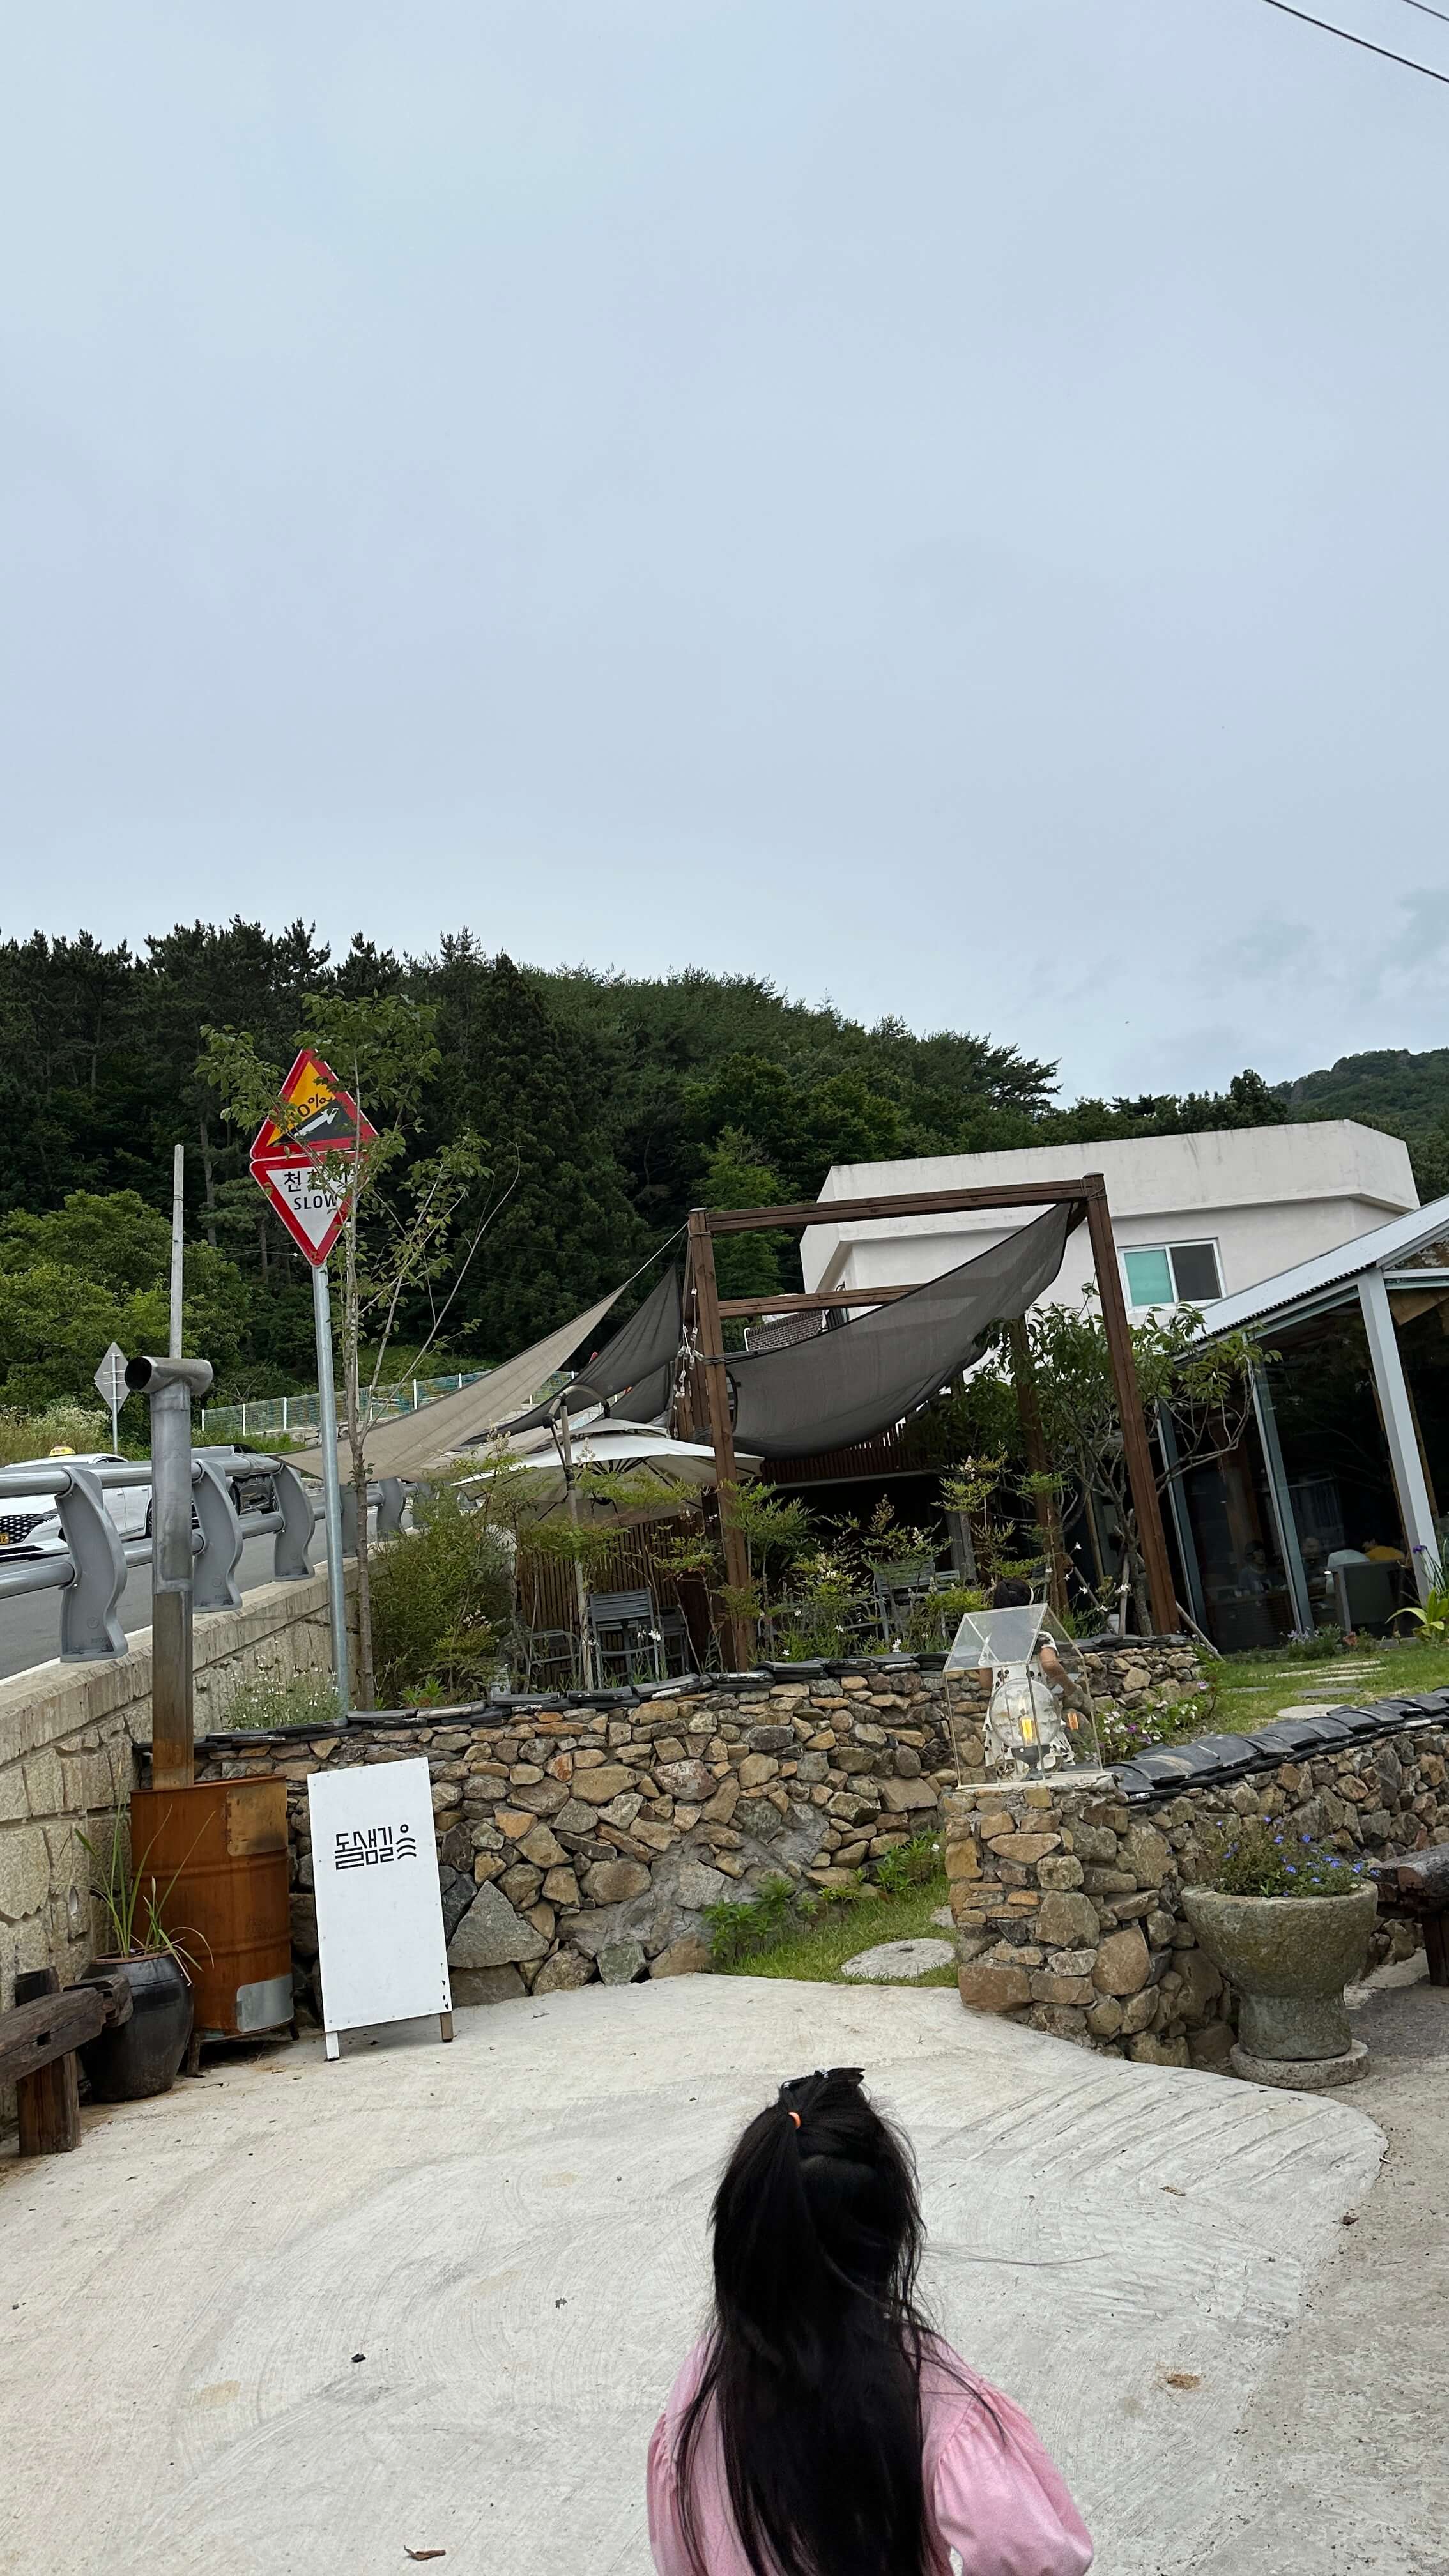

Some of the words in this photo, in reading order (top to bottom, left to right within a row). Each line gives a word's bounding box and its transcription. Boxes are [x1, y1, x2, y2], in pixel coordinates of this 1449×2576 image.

[288, 1093, 326, 1123] 0%
[294, 1195, 337, 1210] SLOW
[335, 1826, 394, 1870] 돌샘길
